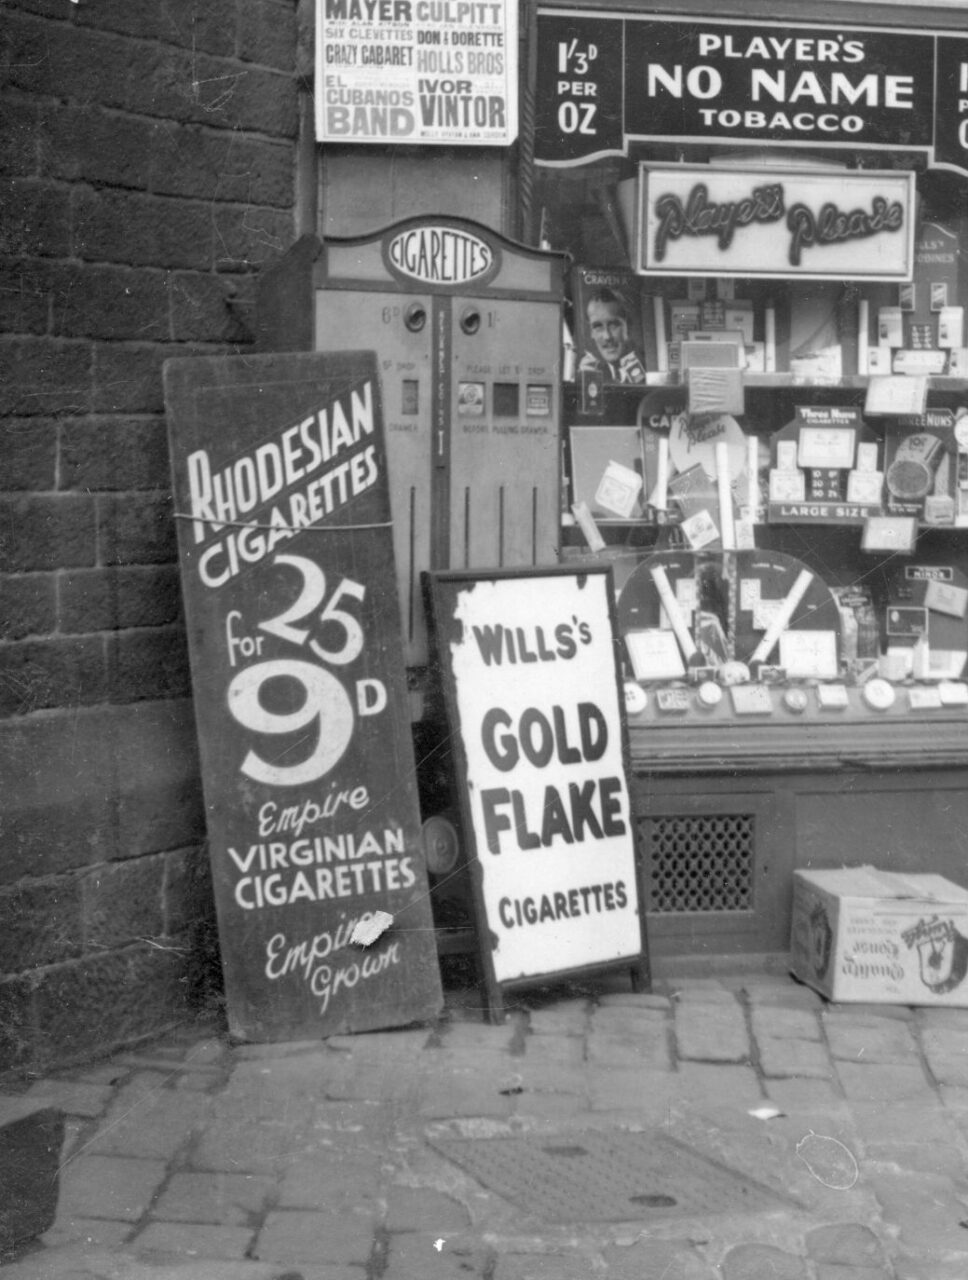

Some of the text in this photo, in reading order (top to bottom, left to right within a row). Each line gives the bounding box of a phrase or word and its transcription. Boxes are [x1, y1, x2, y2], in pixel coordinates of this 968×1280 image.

[415, 0, 503, 25] CULPITT
[324, 27, 345, 40] SIX
[416, 30, 442, 46] DON
[451, 31, 505, 48] DORETTE
[699, 32, 866, 63] PLAYER'S
[325, 44, 414, 67] CRAZY CABARET
[467, 51, 504, 76] BROS
[325, 74, 348, 89] EL
[326, 88, 415, 107] CUBANOS
[417, 78, 473, 95] IVOR
[558, 81, 598, 97] PER
[647, 63, 915, 109] NO NAME
[326, 105, 415, 138] BAND
[419, 94, 506, 129] VINTOR
[557, 101, 598, 135] OZ
[699, 108, 865, 133] TOBACCO
[786, 195, 904, 267] Please
[389, 230, 489, 282] CIGARETTES
[917, 252, 955, 264] ODBINES
[583, 274, 621, 286] CRAVEN
[926, 412, 953, 427] NUNS
[186, 380, 375, 545] RHODESIAN
[198, 444, 379, 589] CIGARETTES
[781, 506, 869, 518] LARGE SIZE
[257, 553, 367, 666] 25
[480, 701, 609, 773] GOLD
[258, 781, 371, 838] Empire
[480, 775, 627, 856] FLAKE
[226, 827, 406, 874] VIRGINIAN
[234, 856, 417, 910] CIGARETTES
[498, 880, 629, 929] CIGARETTES
[310, 943, 401, 1016] Grown
